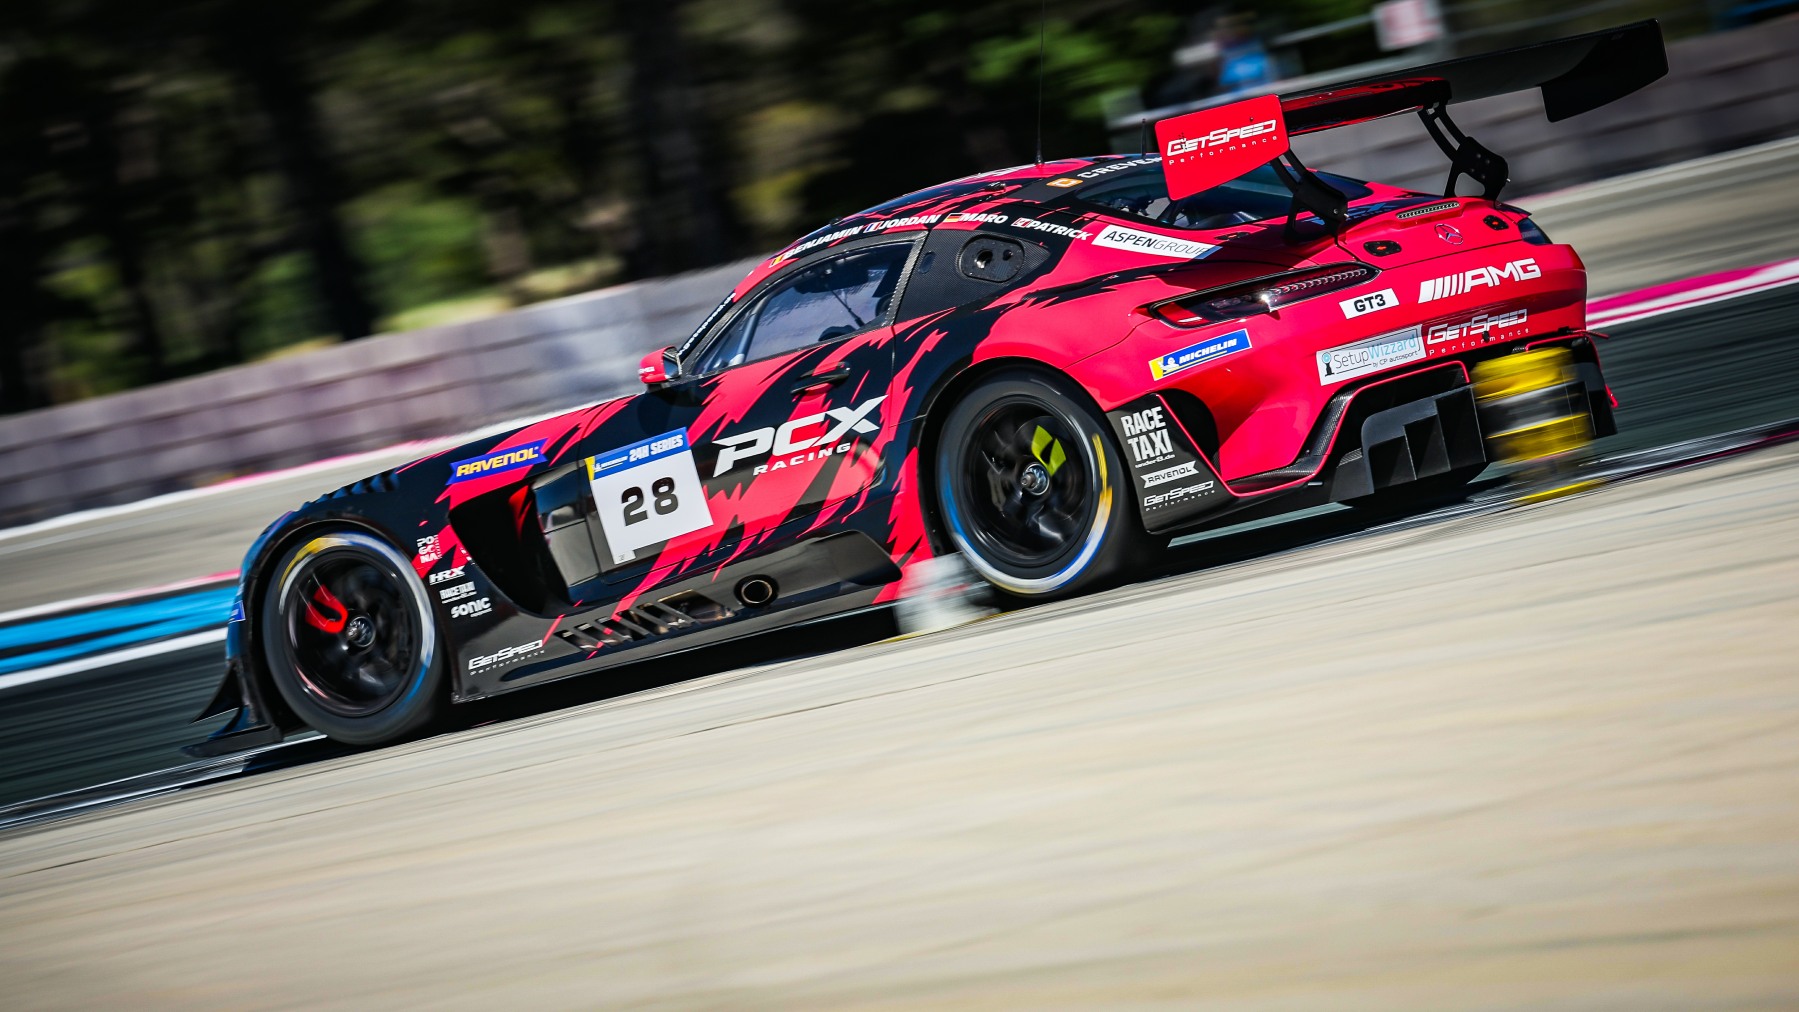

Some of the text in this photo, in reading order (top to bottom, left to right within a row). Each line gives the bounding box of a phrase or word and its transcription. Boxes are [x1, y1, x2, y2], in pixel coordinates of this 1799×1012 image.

[1169, 136, 1278, 165] Performance
[878, 214, 942, 230] JORDAN
[961, 212, 1008, 224] MARO
[1027, 219, 1093, 241] PATRICK
[784, 226, 863, 259] BENJAMIN
[1103, 231, 1210, 256] ASPENGROUP
[1354, 293, 1386, 313] GT3
[1179, 338, 1237, 364] MICHELIN
[1334, 334, 1416, 369] SetupWizzard
[1429, 328, 1529, 356] Performance
[1389, 350, 1418, 363] autosport
[1121, 406, 1166, 437] RACE
[629, 444, 649, 462] 24H
[651, 434, 683, 454] SERIES
[712, 395, 888, 477] PCX
[1127, 429, 1173, 461] TAXI
[753, 443, 850, 475] RACING
[1148, 467, 1192, 483] RAVENOL
[621, 477, 678, 526] 28
[429, 565, 465, 584] HRX
